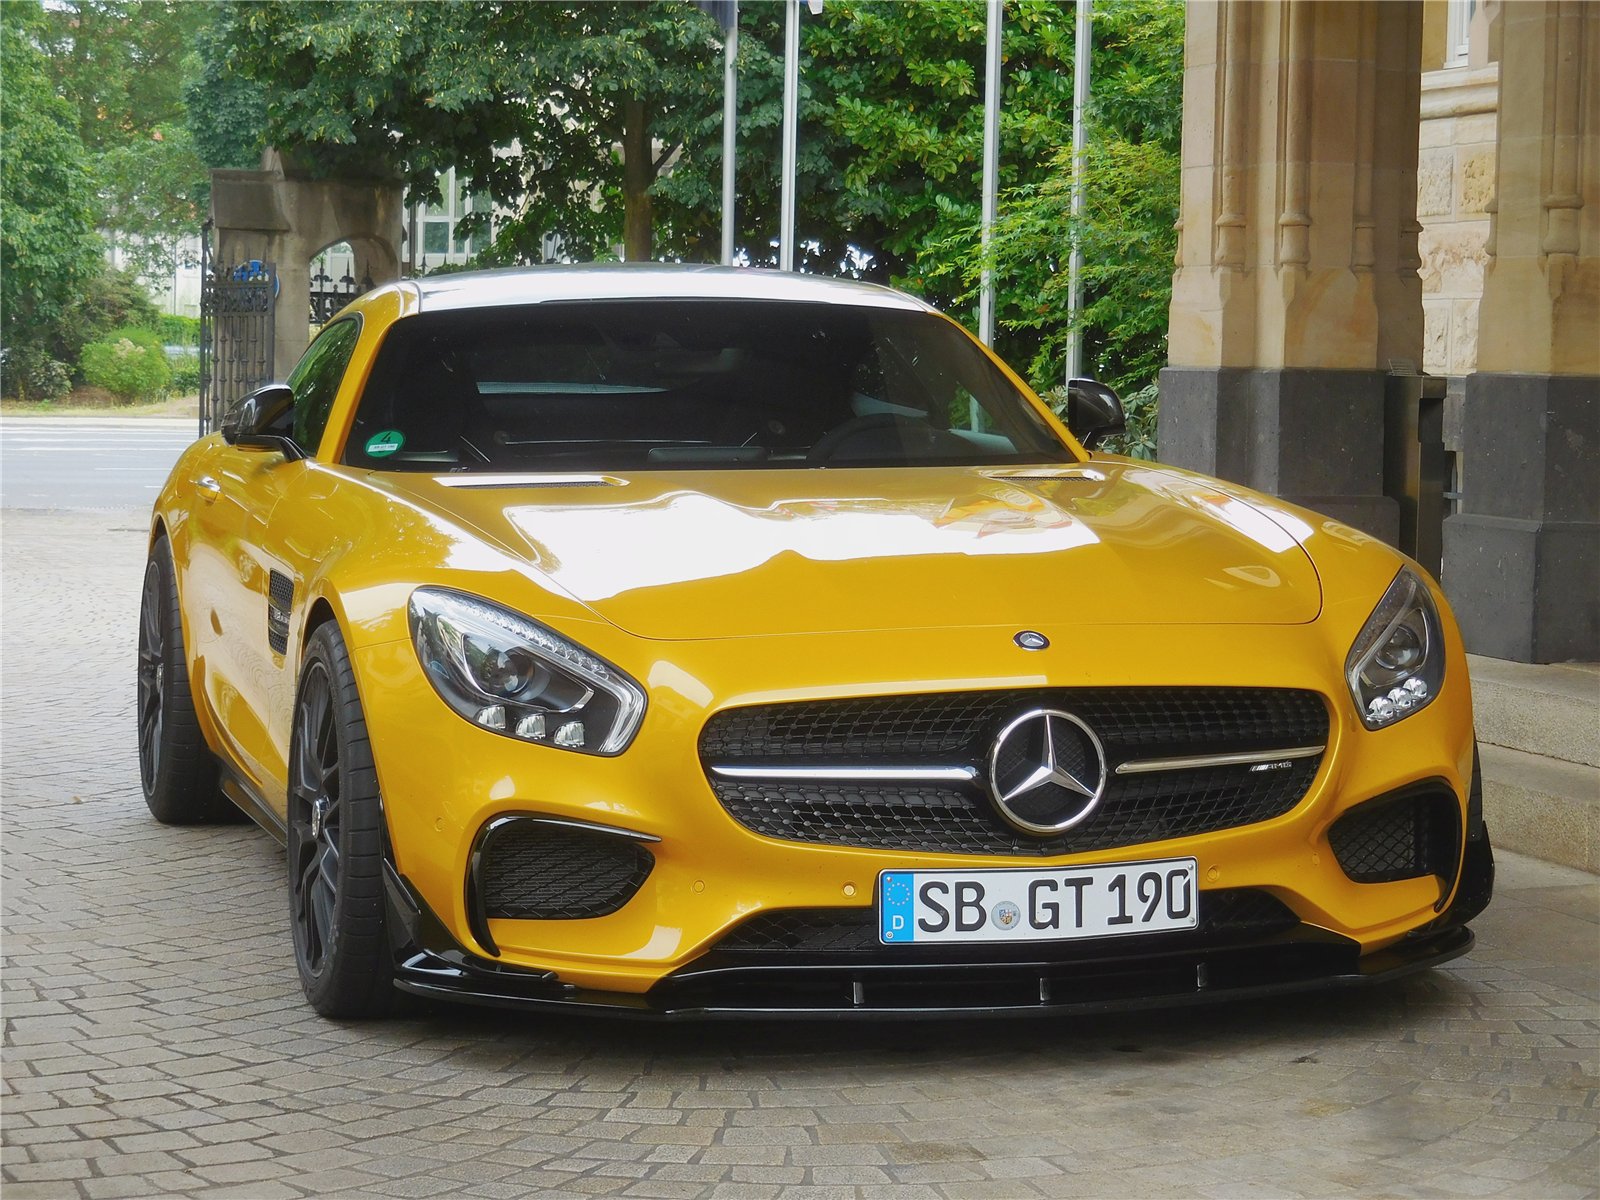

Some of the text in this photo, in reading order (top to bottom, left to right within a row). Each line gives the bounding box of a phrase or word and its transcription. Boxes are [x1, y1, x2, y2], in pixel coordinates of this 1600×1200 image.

[381, 431, 391, 444] 4
[918, 868, 1191, 932] SB GT 190
[892, 915, 904, 930] D
